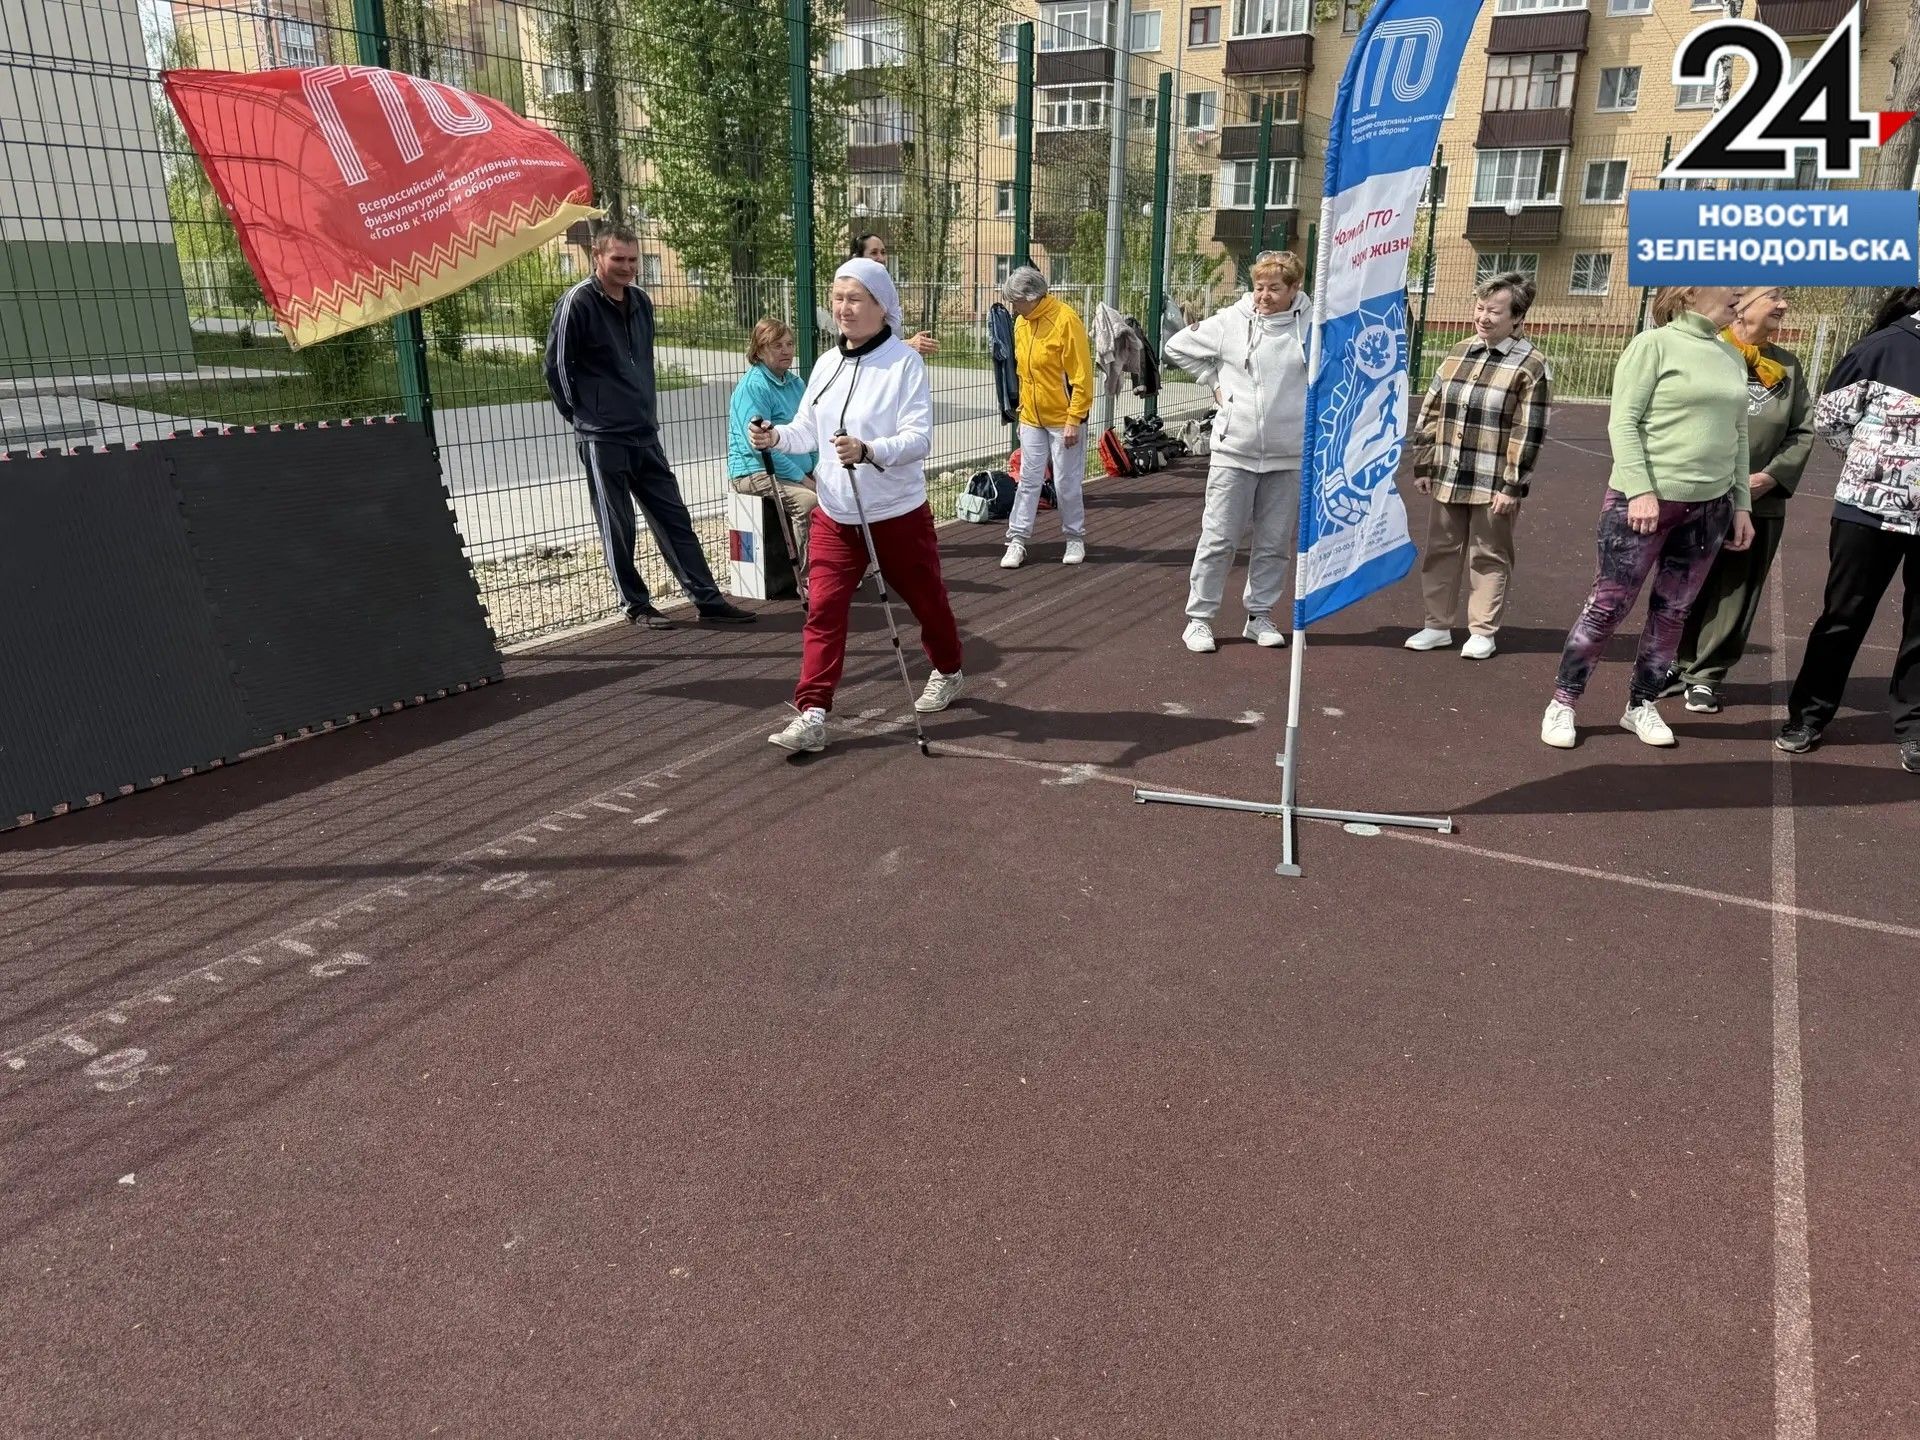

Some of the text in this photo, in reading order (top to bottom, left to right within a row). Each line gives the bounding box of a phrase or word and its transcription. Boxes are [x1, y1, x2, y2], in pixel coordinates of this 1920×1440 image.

[1351, 16, 1443, 112] ГТО
[301, 64, 492, 187] ГТО
[357, 169, 447, 215] Всероссийский
[364, 157, 518, 229] физкультурно-спортивный
[369, 170, 521, 241] «Готов к труду и обороне»
[1365, 208, 1393, 231] ГТО
